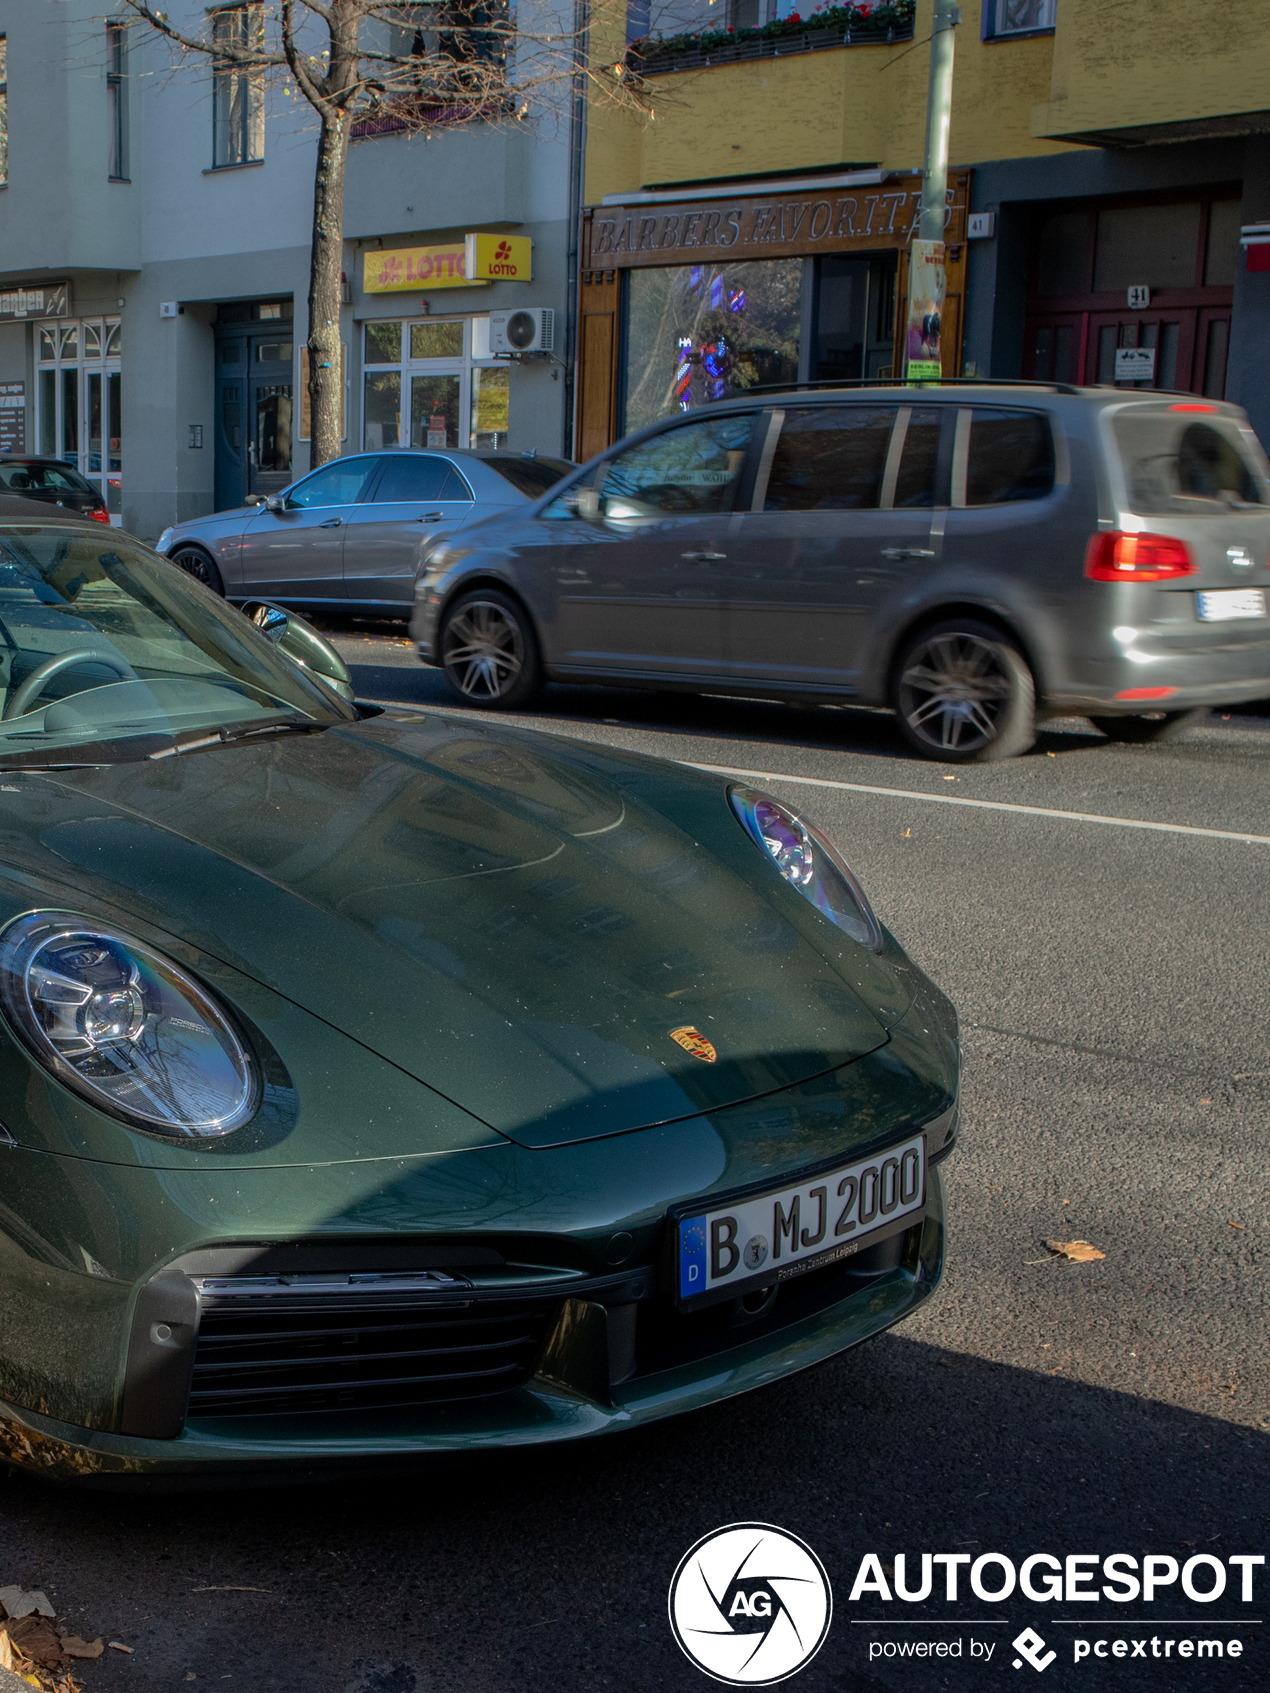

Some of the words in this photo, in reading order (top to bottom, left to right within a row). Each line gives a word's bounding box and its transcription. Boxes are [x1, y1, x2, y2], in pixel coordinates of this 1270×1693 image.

[593, 208, 742, 254] BARBERS
[972, 219, 982, 231] 41
[489, 263, 517, 276] LOTTO
[1131, 288, 1146, 301] 41
[710, 1216, 740, 1280] B
[773, 1186, 827, 1259] MJ
[834, 1147, 920, 1236] 2000
[836, 1242, 859, 1258] Leipzig
[688, 1264, 699, 1282] D
